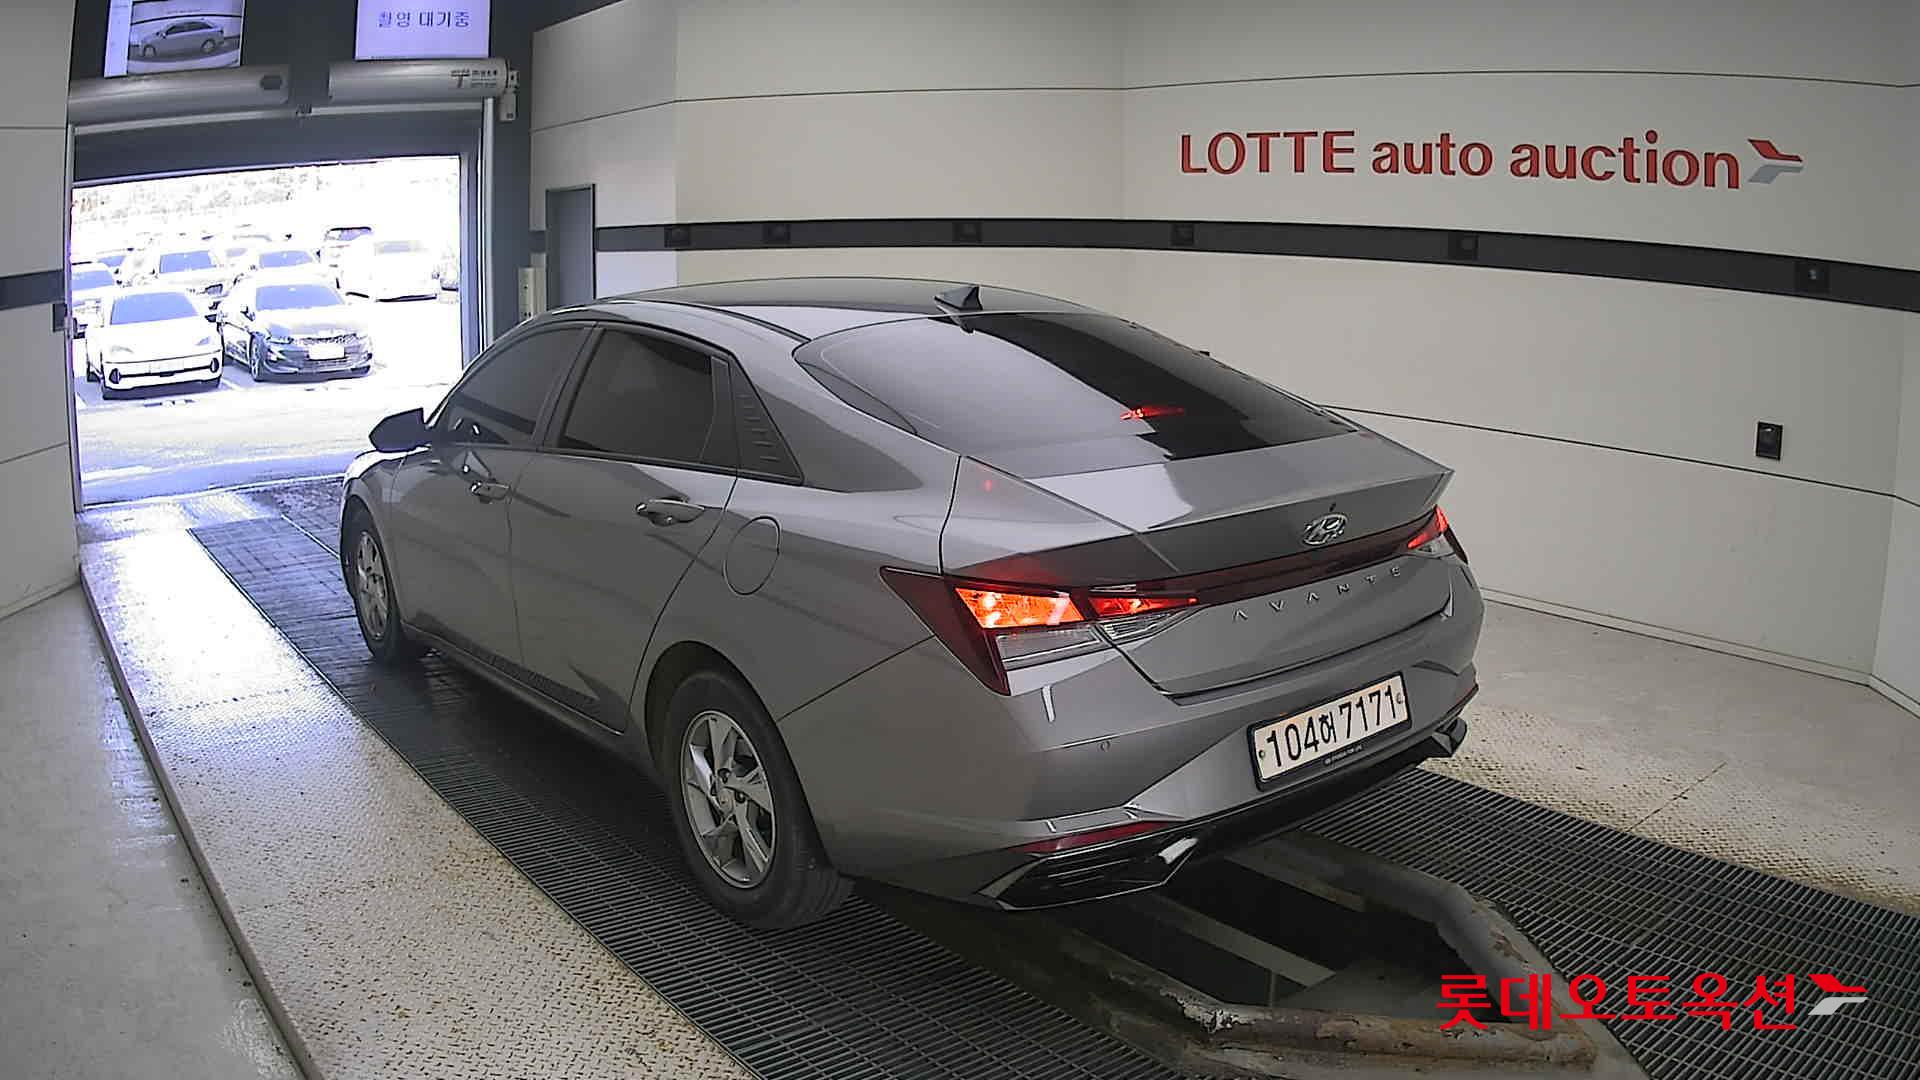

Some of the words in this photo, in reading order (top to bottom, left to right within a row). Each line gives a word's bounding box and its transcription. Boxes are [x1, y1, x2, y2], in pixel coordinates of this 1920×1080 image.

[419, 11, 470, 28] 대기중
[1180, 130, 1356, 174] LOTTE
[1372, 133, 1493, 176] auto
[1510, 130, 1739, 189] auction
[1232, 567, 1402, 623] AVANTE
[1266, 711, 1337, 767] 104허
[1339, 685, 1396, 739] 7171
